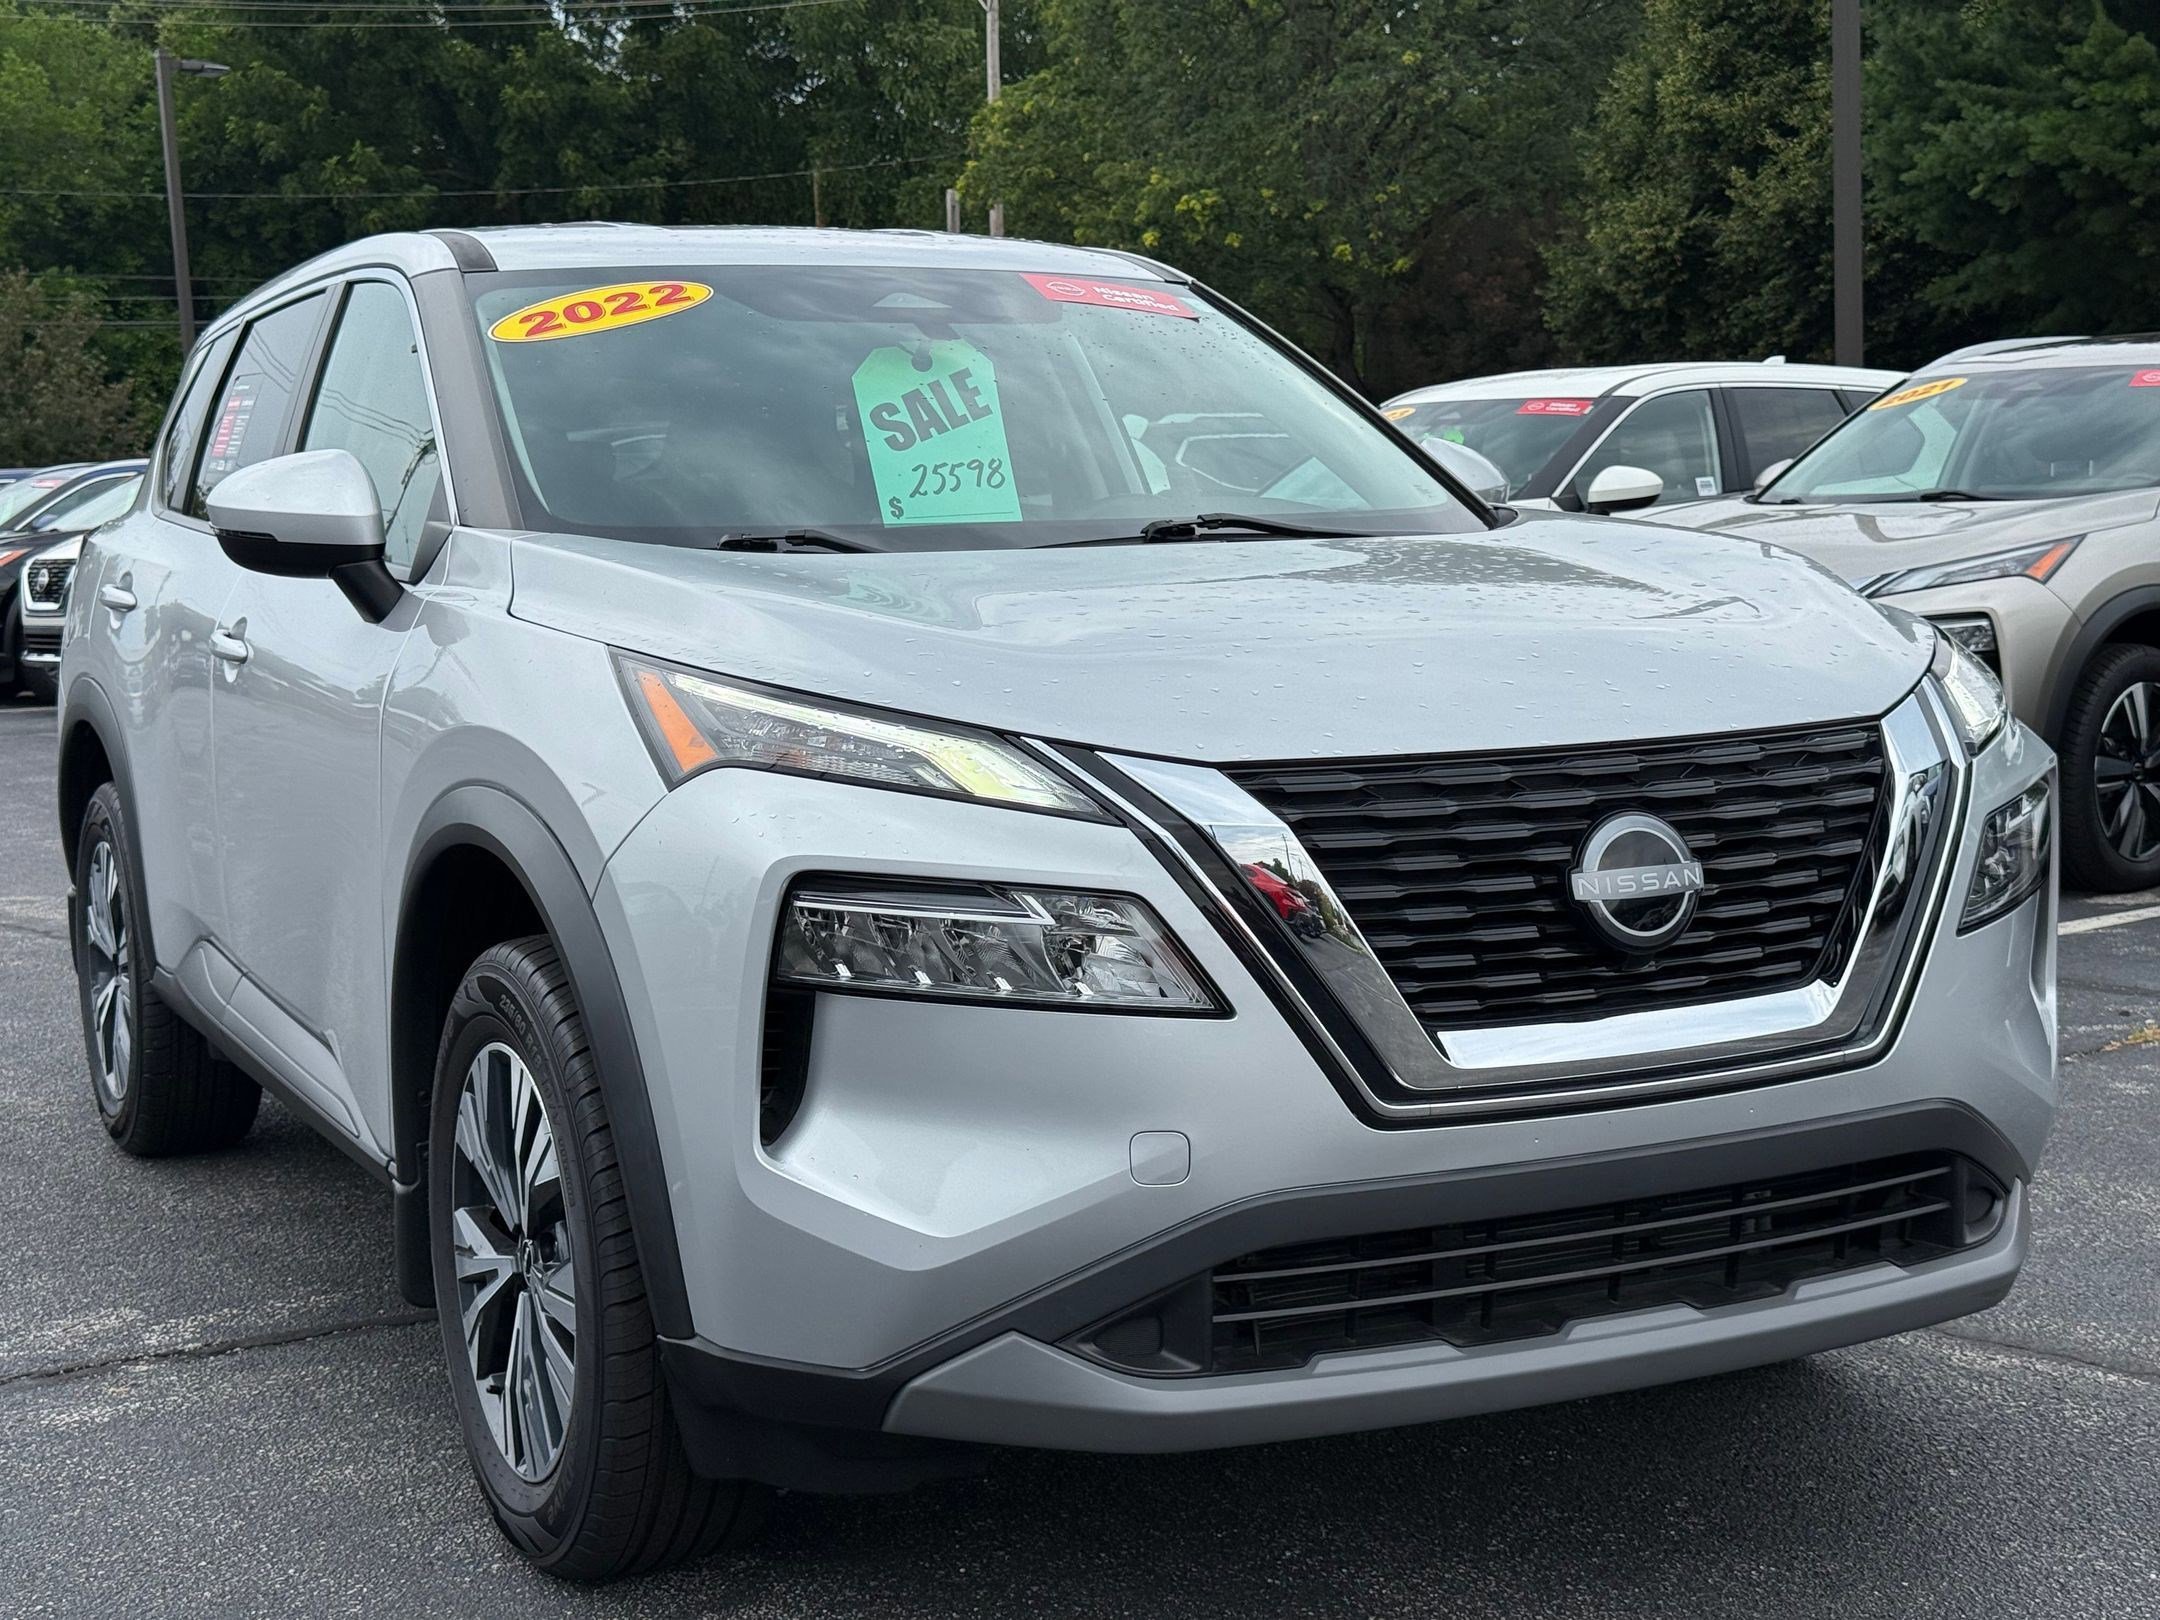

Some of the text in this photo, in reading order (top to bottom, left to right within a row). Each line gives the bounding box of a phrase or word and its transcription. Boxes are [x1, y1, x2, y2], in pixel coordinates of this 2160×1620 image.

[518, 284, 695, 337] 2022
[1092, 286, 1156, 301] Nissan
[1102, 294, 1180, 312] Certified
[869, 367, 994, 452] SALE
[888, 458, 1006, 519] $ 25598
[1577, 867, 1701, 896] NISSAN
